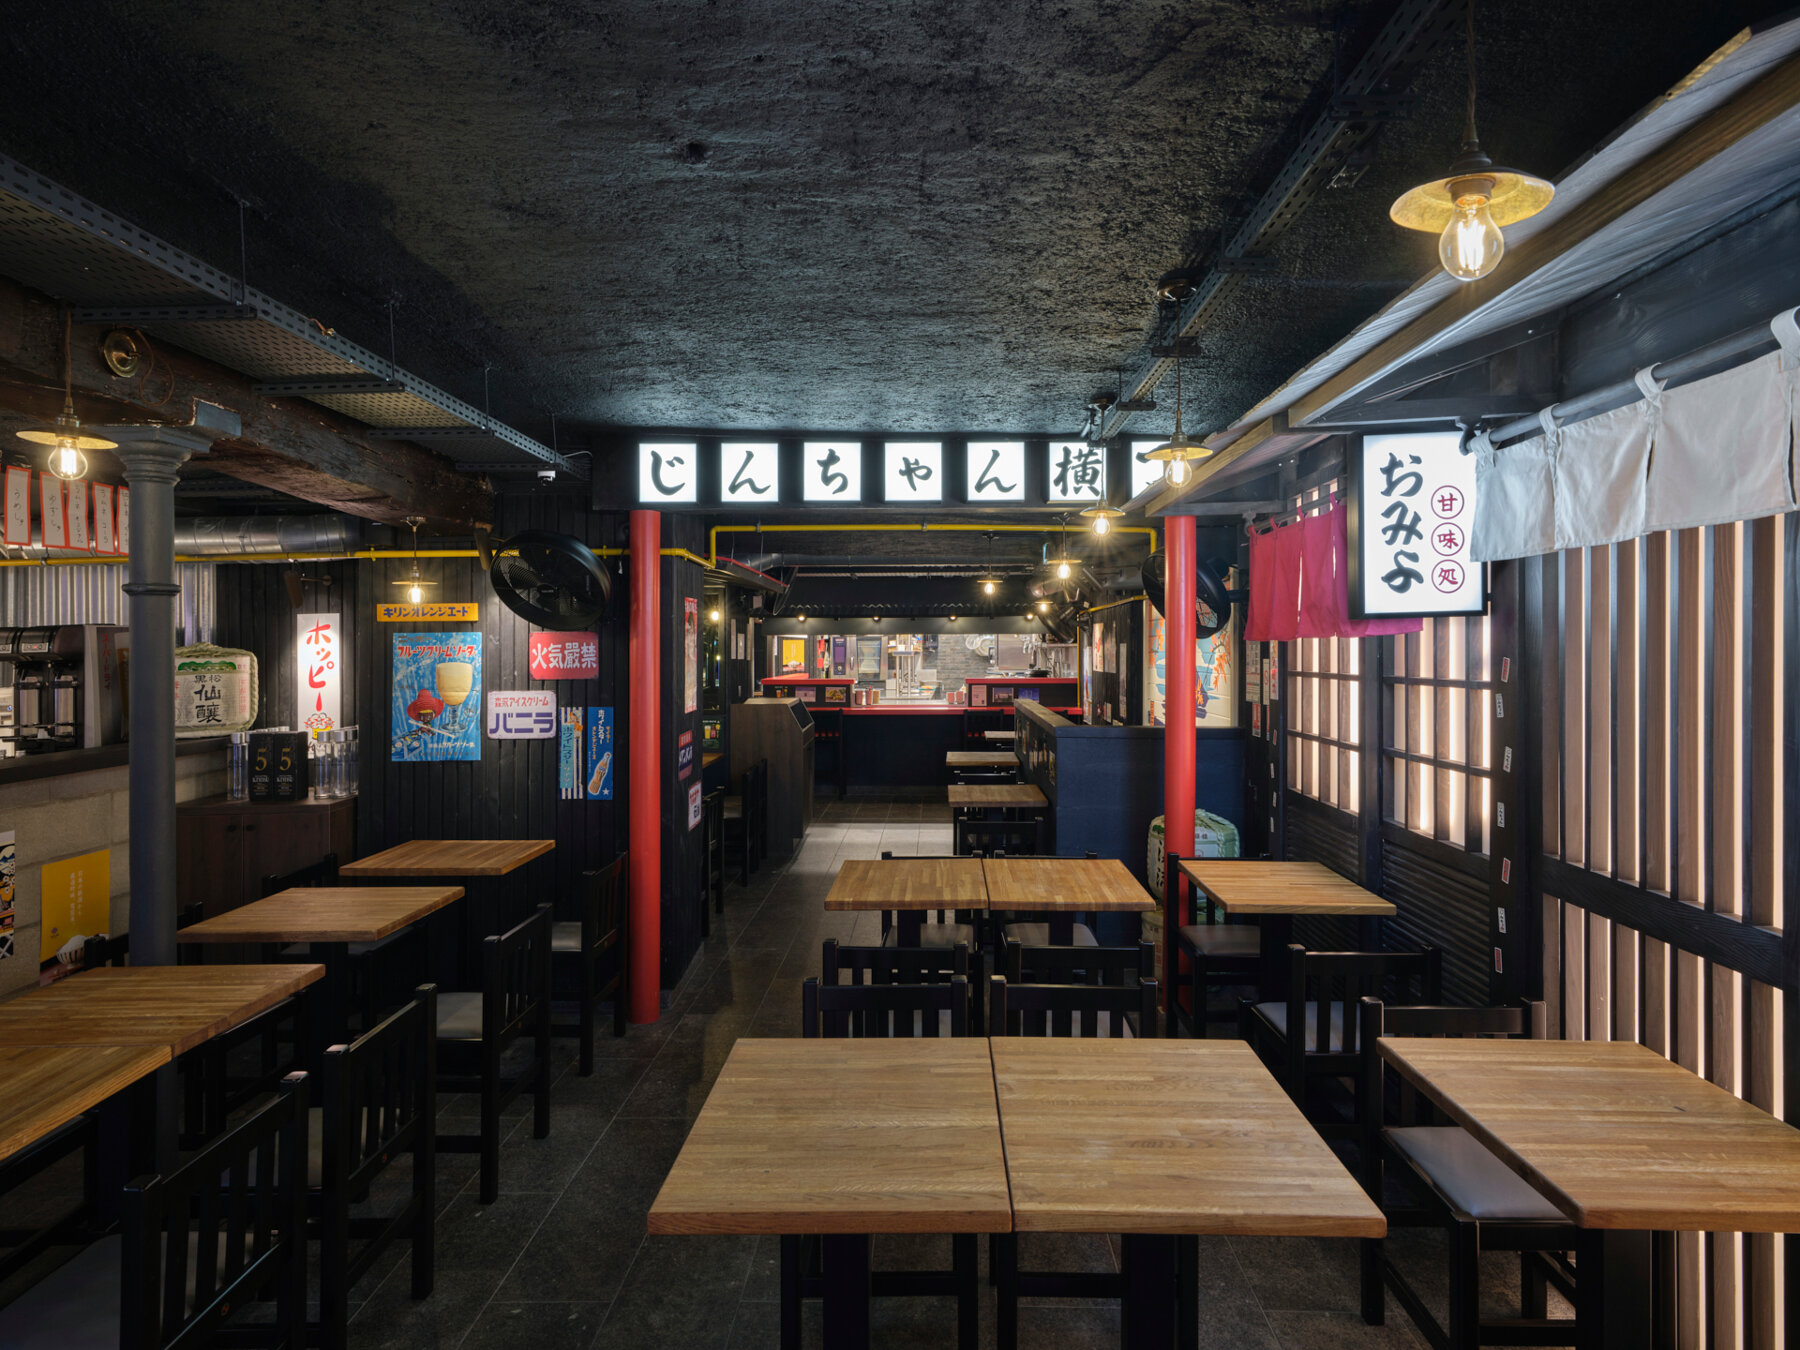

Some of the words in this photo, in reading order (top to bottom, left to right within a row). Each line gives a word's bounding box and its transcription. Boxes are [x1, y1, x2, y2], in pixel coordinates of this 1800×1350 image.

[650, 446, 1157, 496] じんちゃん横
[1379, 452, 1424, 594] おみよ
[1436, 491, 1460, 587] 甘味処
[306, 618, 335, 712] ホッピー
[397, 645, 476, 658] フルーツクリームソーダ
[489, 712, 554, 734] バニラ
[255, 748, 268, 771] 5
[279, 748, 292, 771] 5
